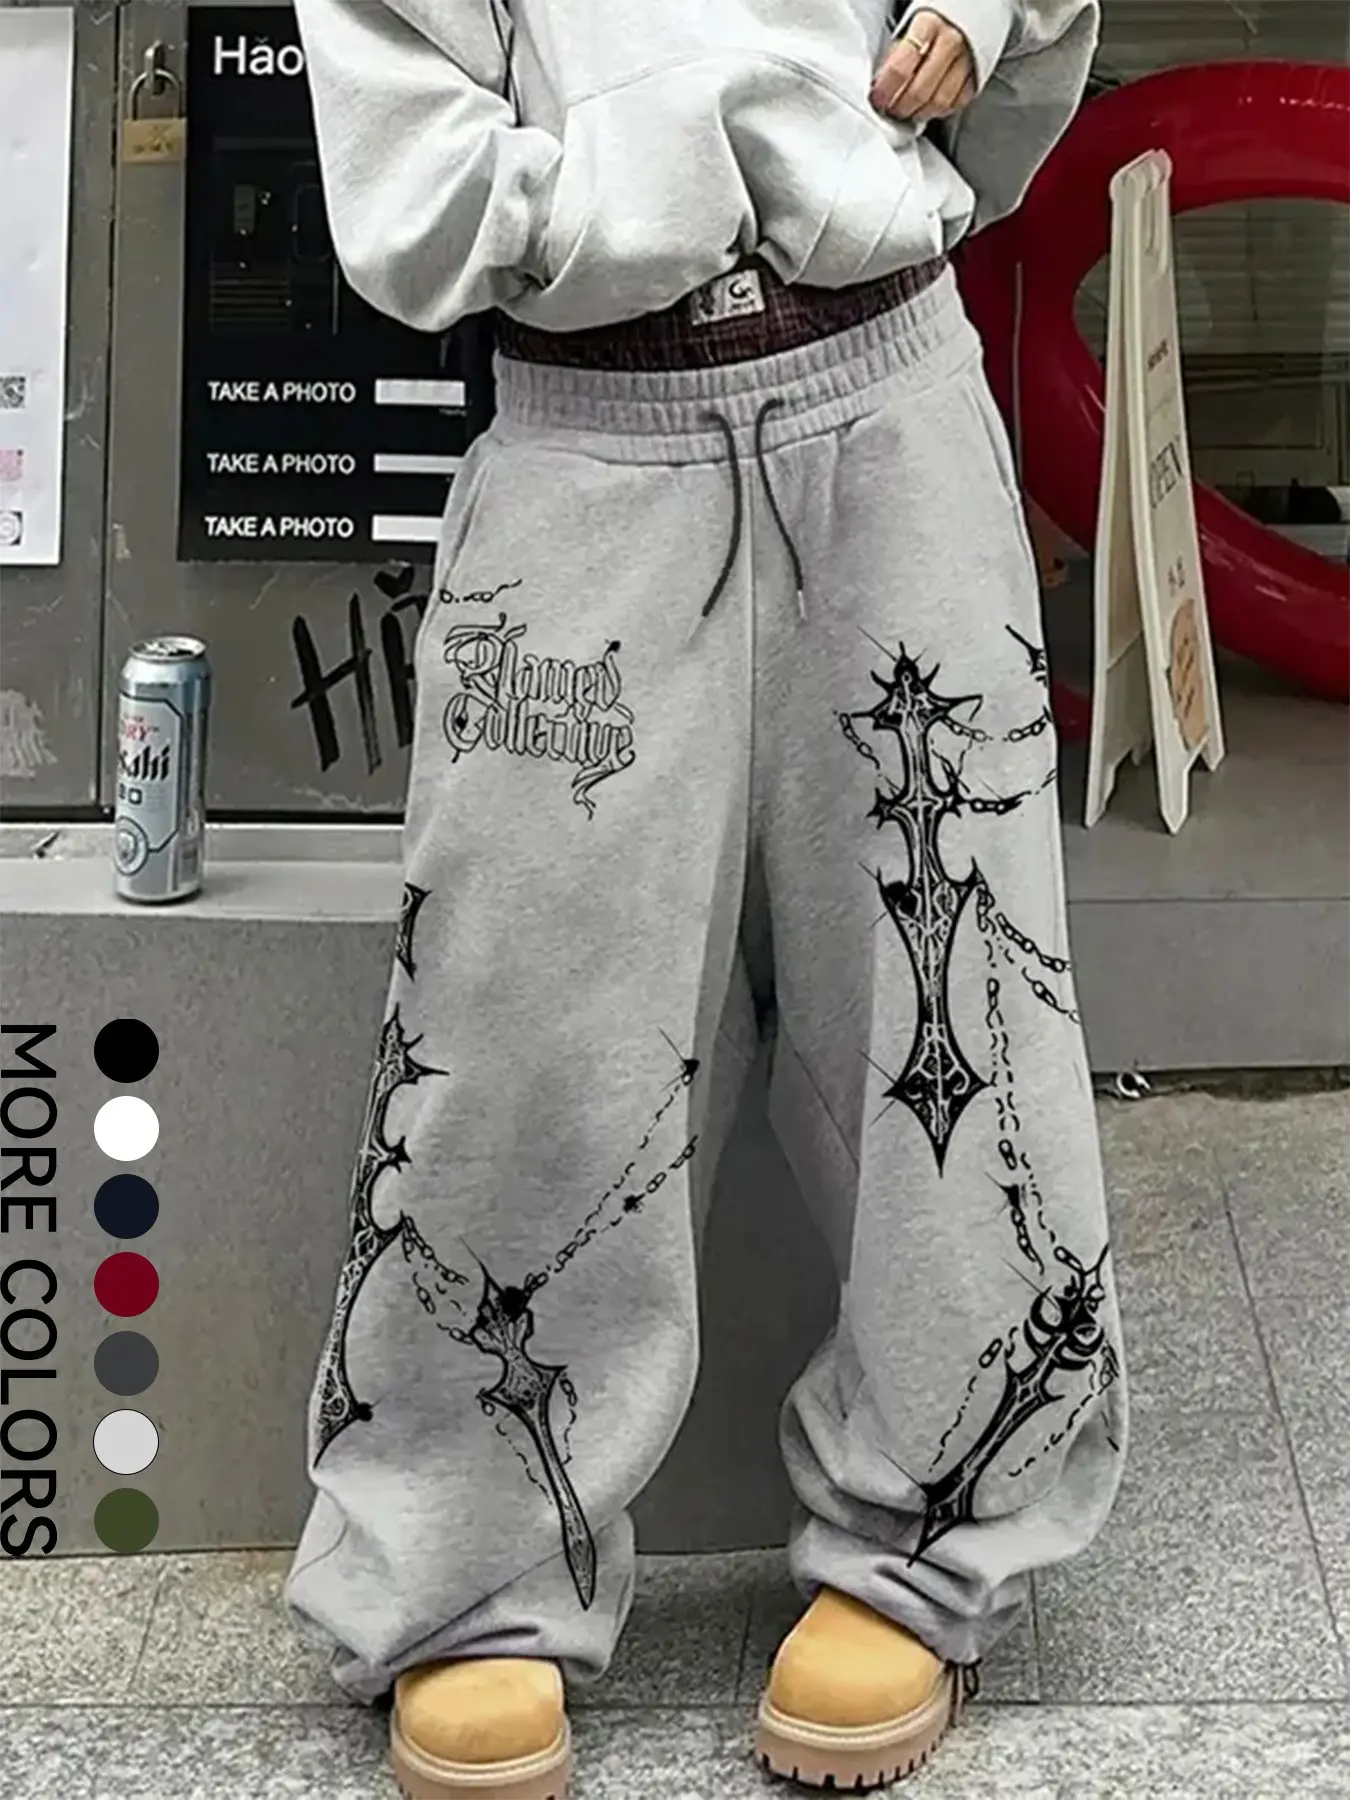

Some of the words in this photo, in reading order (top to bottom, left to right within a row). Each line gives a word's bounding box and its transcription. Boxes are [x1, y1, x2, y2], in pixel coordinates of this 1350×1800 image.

[207, 381, 260, 401] TAKE
[263, 381, 279, 401] A
[282, 381, 356, 403] PHOTO
[206, 453, 259, 473] TAKE
[262, 453, 278, 473] A
[281, 453, 356, 475] PHOTO
[204, 516, 258, 537] TAKE
[260, 516, 277, 537] A
[279, 516, 354, 538] PHOTO
